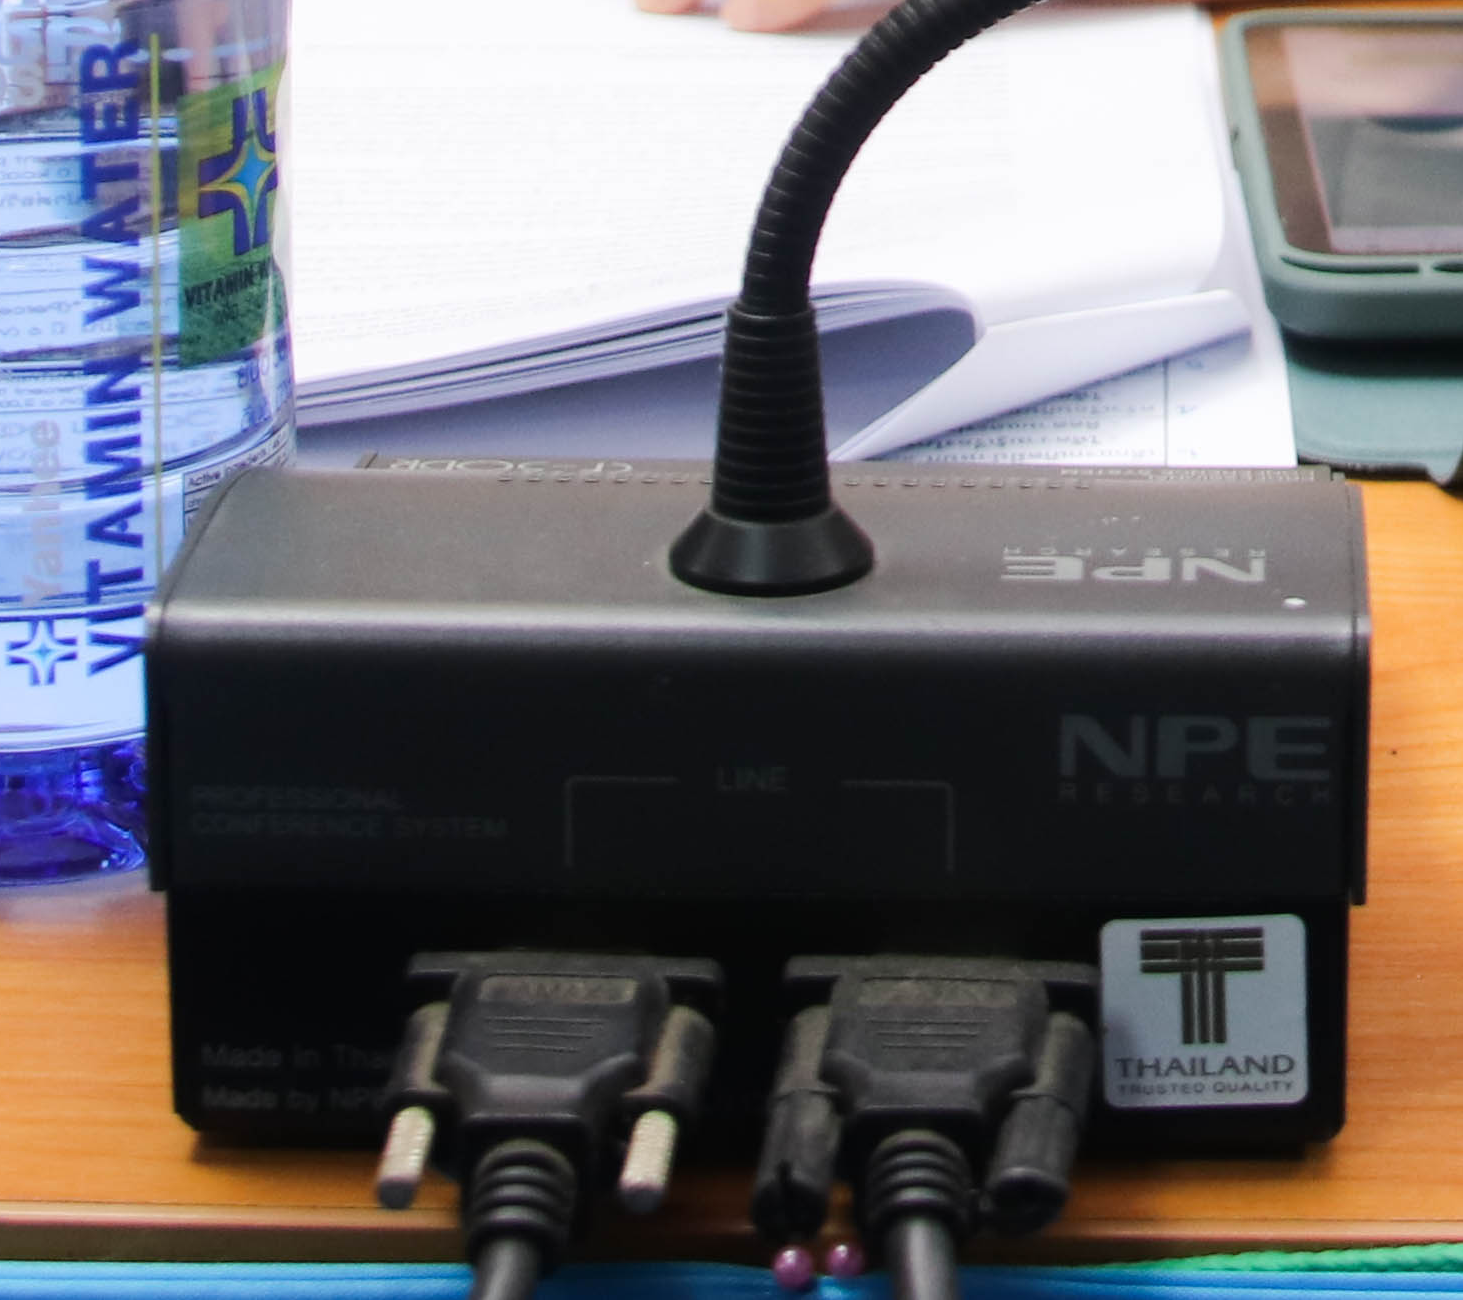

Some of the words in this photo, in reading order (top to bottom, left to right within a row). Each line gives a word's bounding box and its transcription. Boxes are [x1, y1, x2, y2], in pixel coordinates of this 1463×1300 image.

[80, 36, 142, 326] WATER
[84, 352, 144, 677] VITAMIN
[1058, 712, 1332, 782] NPE
[715, 765, 790, 793] LINE
[1114, 1054, 1297, 1079] THAILAND
[1211, 1079, 1295, 1095] QUALITY
